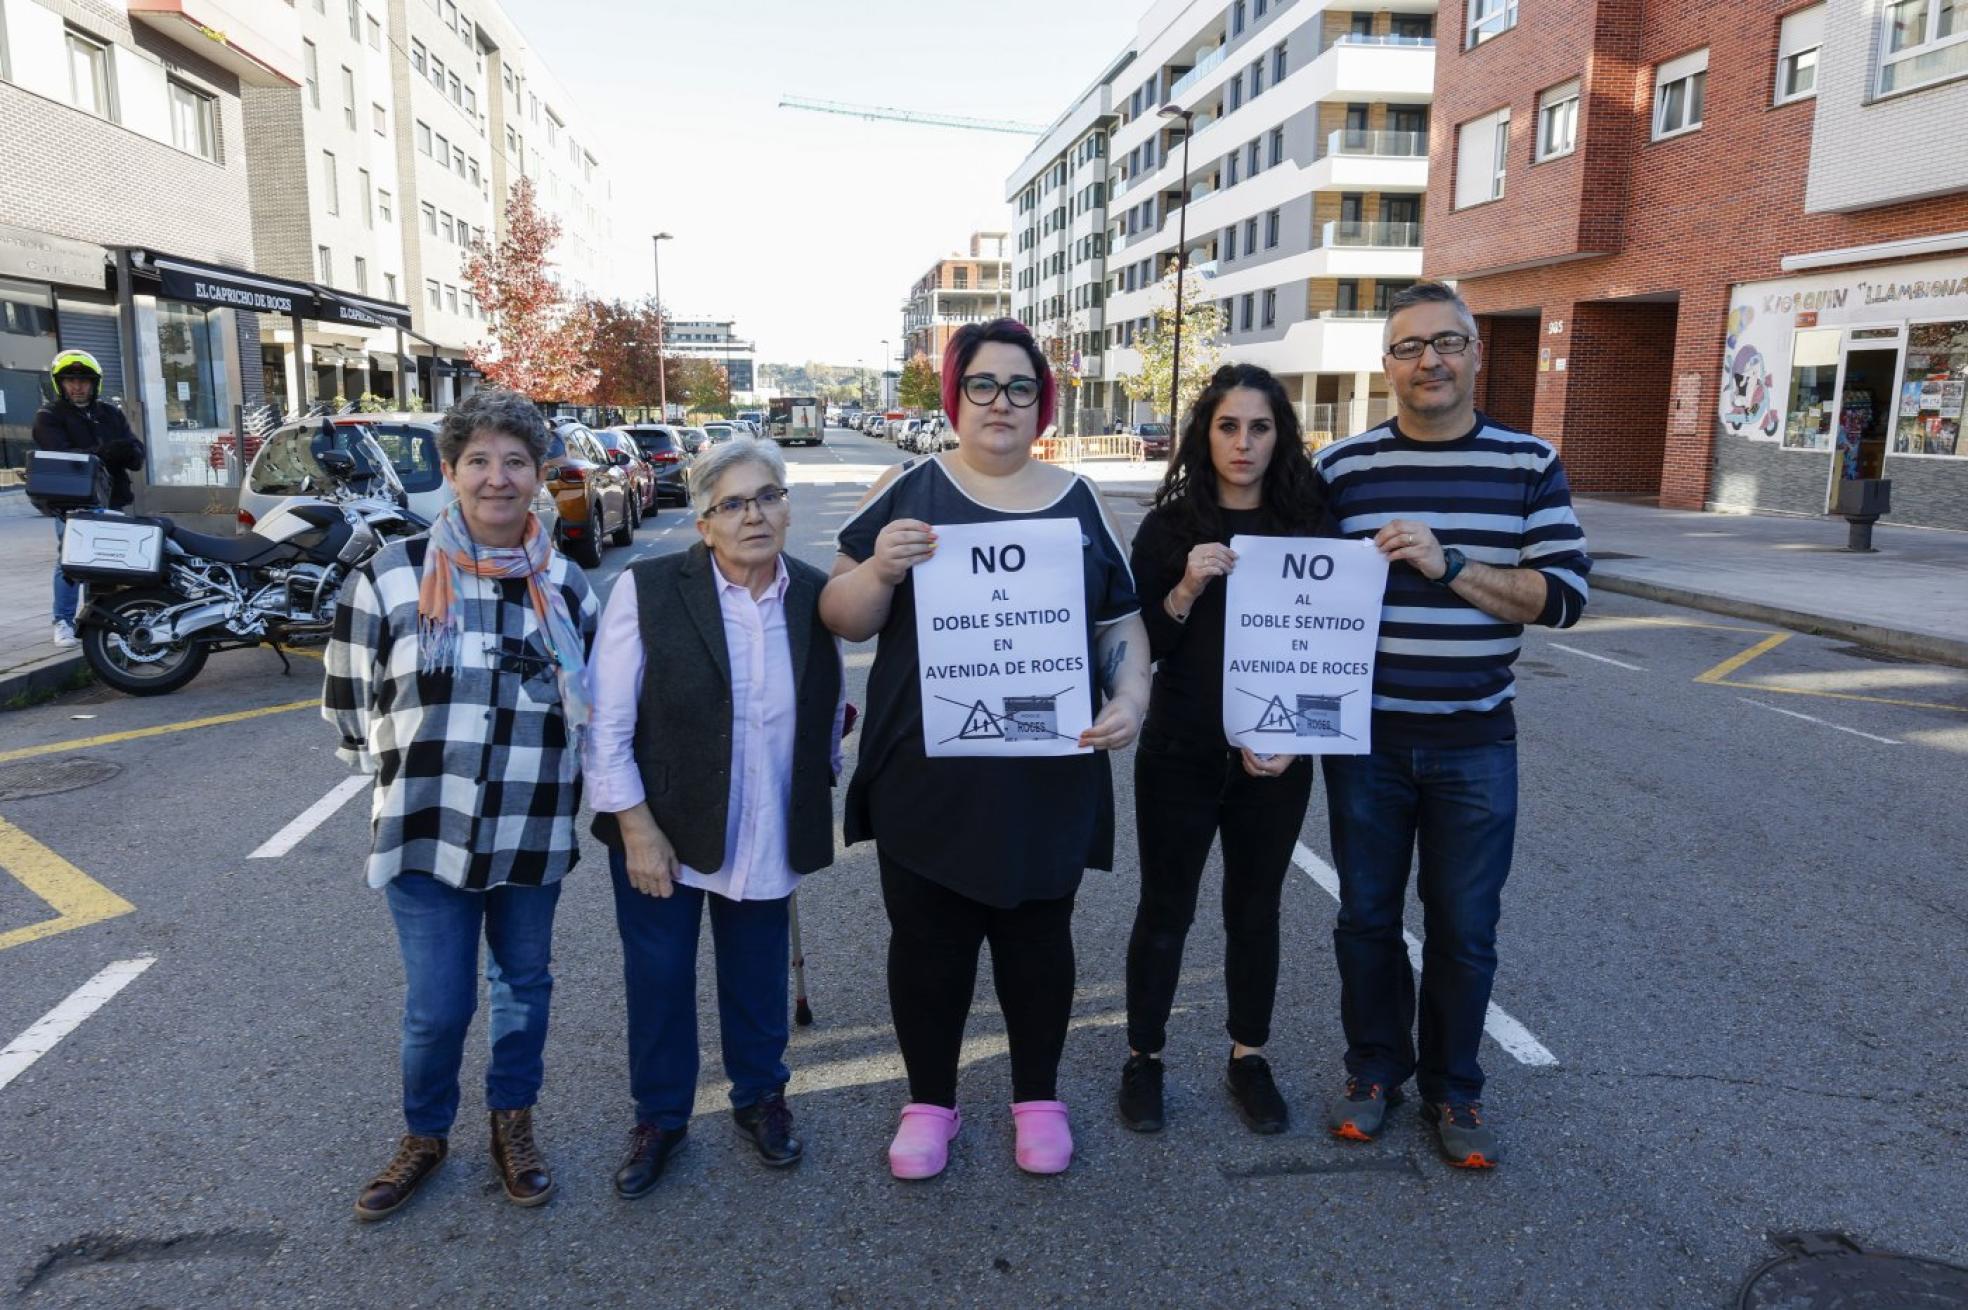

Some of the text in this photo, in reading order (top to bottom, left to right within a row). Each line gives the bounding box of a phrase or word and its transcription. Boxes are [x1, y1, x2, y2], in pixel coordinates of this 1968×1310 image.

[195, 282, 292, 312] EL CAPRICHO DE ROCES
[971, 544, 1026, 574] NO
[1282, 553, 1334, 580] NO
[992, 589, 1009, 601] AL
[1295, 594, 1312, 605] AL
[932, 608, 1070, 631] DOBLE SENTIDO
[1240, 613, 1365, 631] DOBLE SENTIDO
[993, 638, 1013, 651] EN
[1291, 639, 1308, 651] EN
[926, 657, 1083, 679] AVENIDA DE ROCES
[1229, 659, 1369, 675] AVENIDA DE ROCES
[1017, 721, 1047, 733] ROCES
